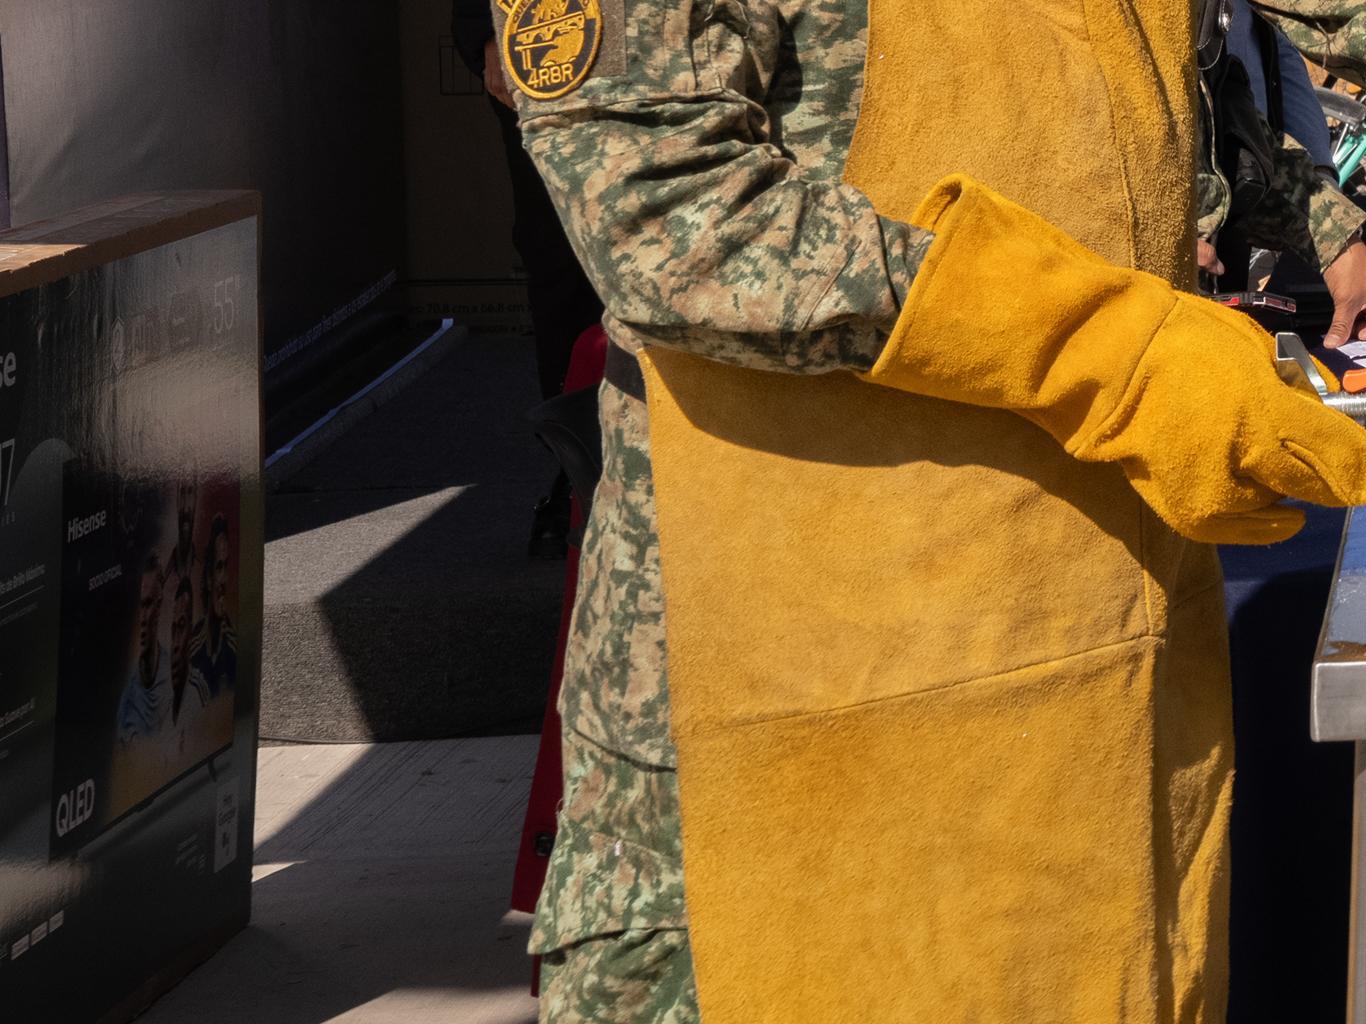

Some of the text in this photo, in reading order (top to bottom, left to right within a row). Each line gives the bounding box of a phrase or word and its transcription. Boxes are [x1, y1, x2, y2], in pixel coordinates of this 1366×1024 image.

[527, 62, 574, 89] 4RBR
[66, 509, 107, 544] Hisense
[55, 777, 97, 839] QLED
